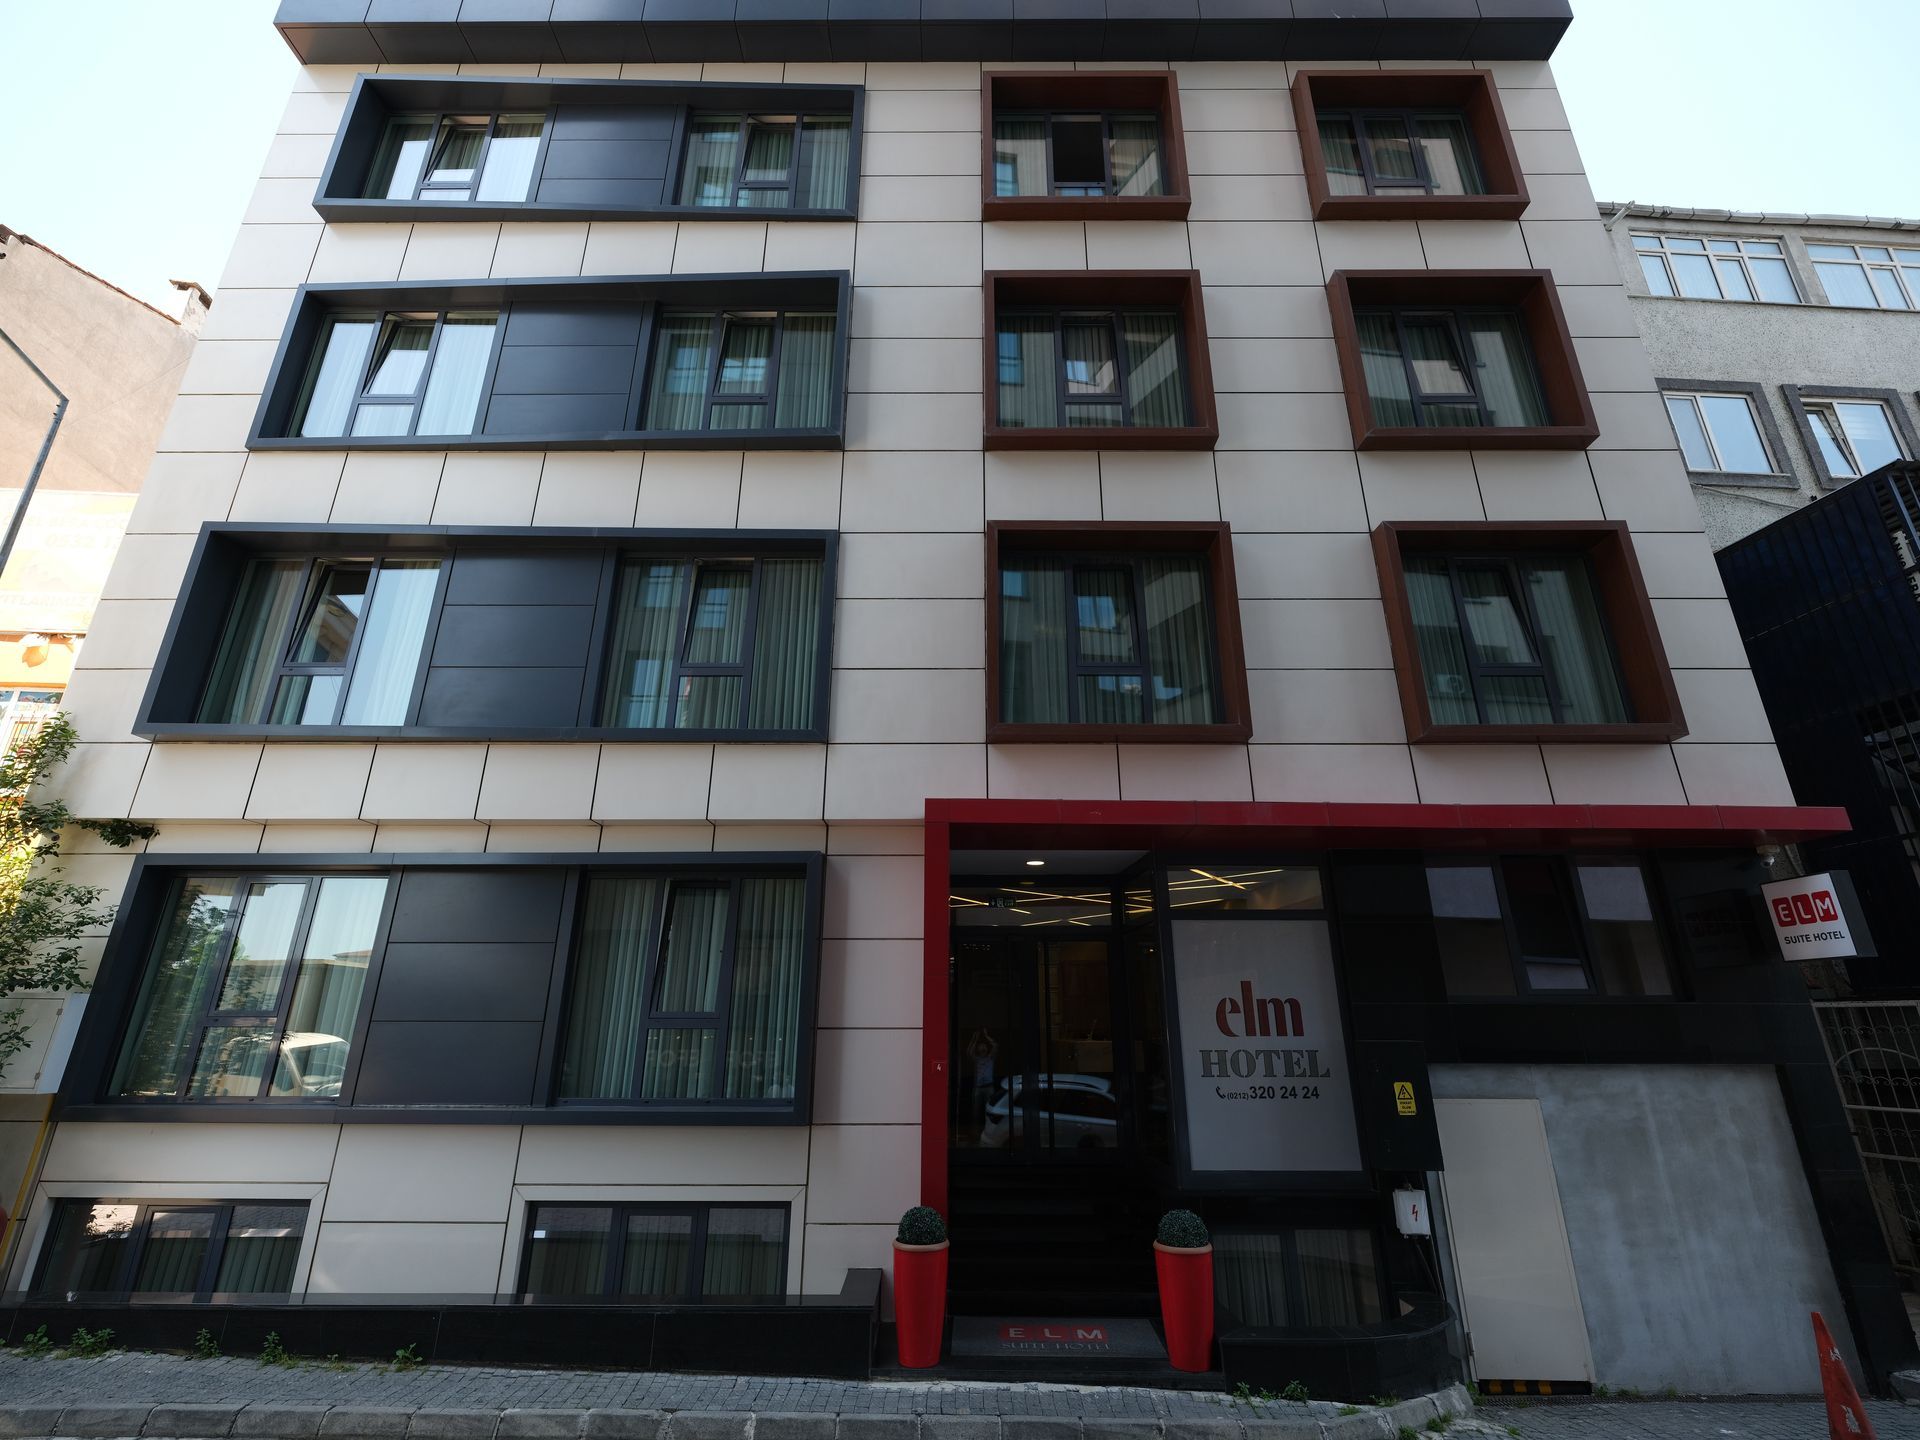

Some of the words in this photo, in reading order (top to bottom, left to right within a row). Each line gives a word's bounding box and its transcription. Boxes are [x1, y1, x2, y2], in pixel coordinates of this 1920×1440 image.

[1777, 897, 1835, 922] ELM
[1784, 934, 1812, 945] SUITE
[1812, 930, 1845, 942] HOTEL
[1215, 980, 1305, 1038] elm
[1199, 1049, 1331, 1079] HOTEL
[1249, 1085, 1275, 1100] 320
[1279, 1085, 1298, 1100] 24
[1302, 1085, 1320, 1100] 24
